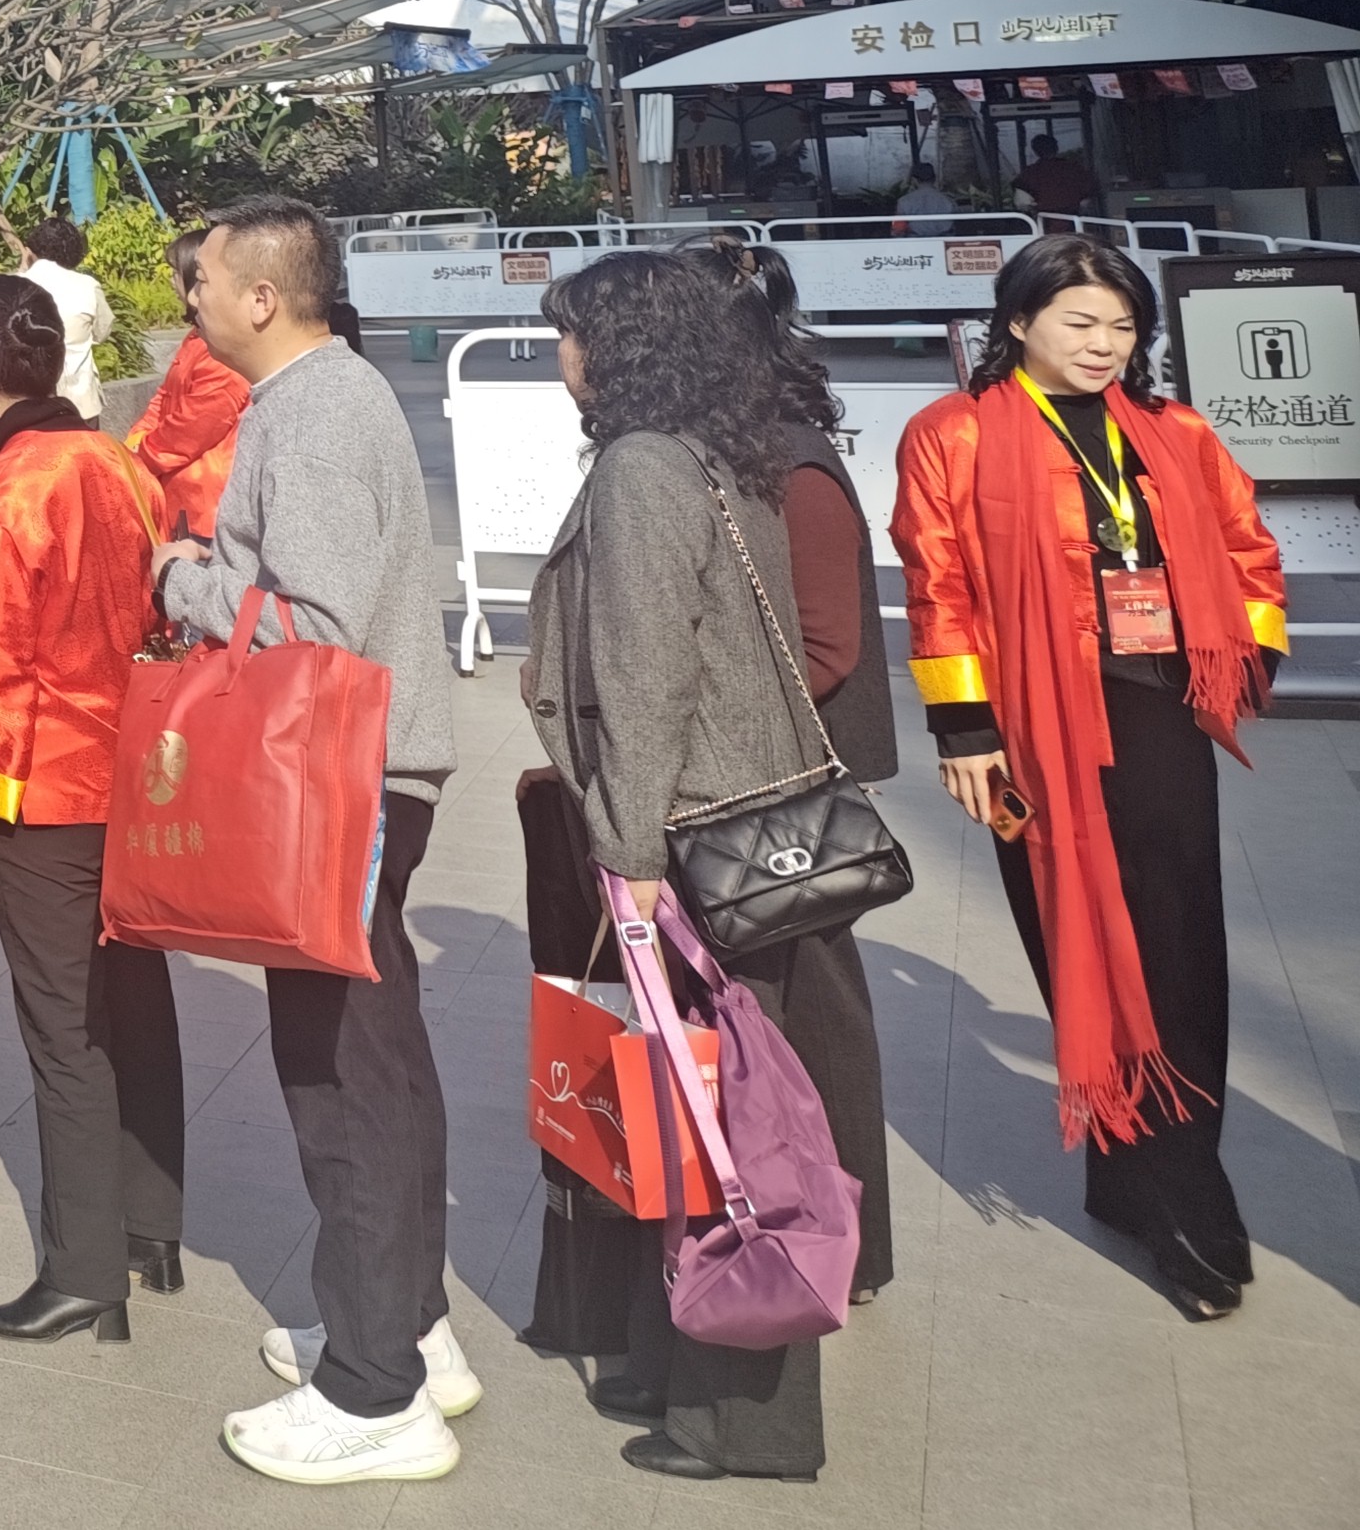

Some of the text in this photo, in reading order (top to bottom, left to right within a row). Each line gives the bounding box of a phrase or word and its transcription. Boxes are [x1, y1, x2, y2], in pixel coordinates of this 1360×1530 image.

[851, 21, 981, 54] 安检口
[1207, 394, 1356, 429] 安检通道
[1228, 435, 1340, 447] Security Checkpoint
